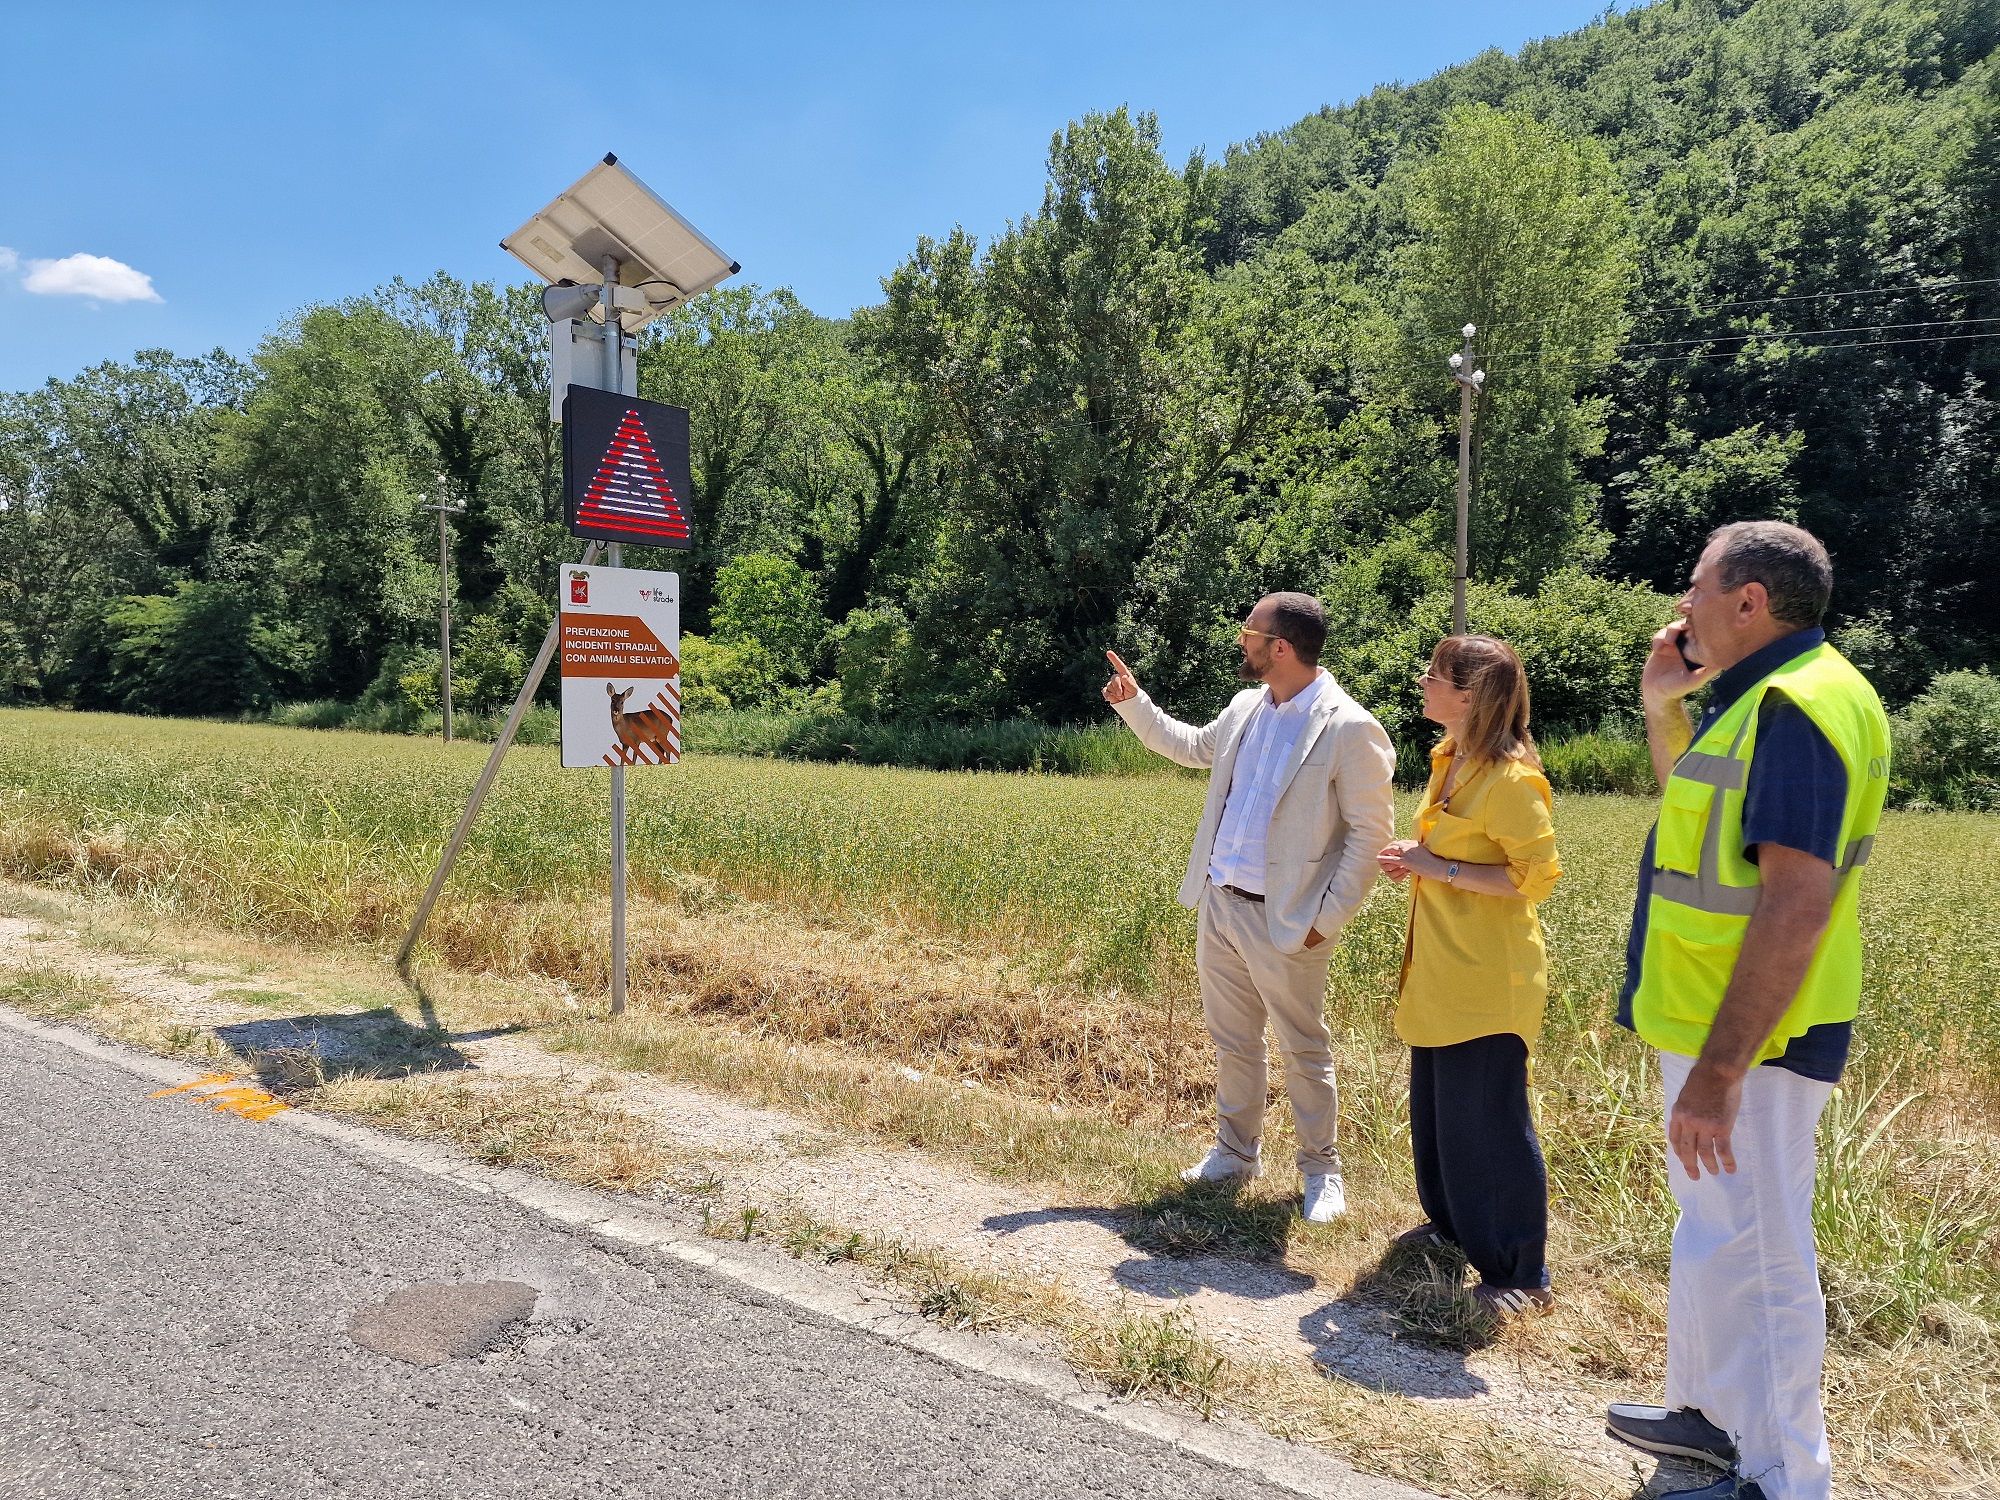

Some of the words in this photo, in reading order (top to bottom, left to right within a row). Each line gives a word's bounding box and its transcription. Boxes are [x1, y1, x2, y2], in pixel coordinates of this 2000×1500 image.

[565, 627, 630, 637] PREVENZIONE
[565, 641, 612, 650] INCIDENTI
[614, 643, 657, 652] STRADALI
[565, 654, 586, 663] CON
[589, 655, 627, 664] ANIMALI
[629, 656, 673, 665] SELVATICI
